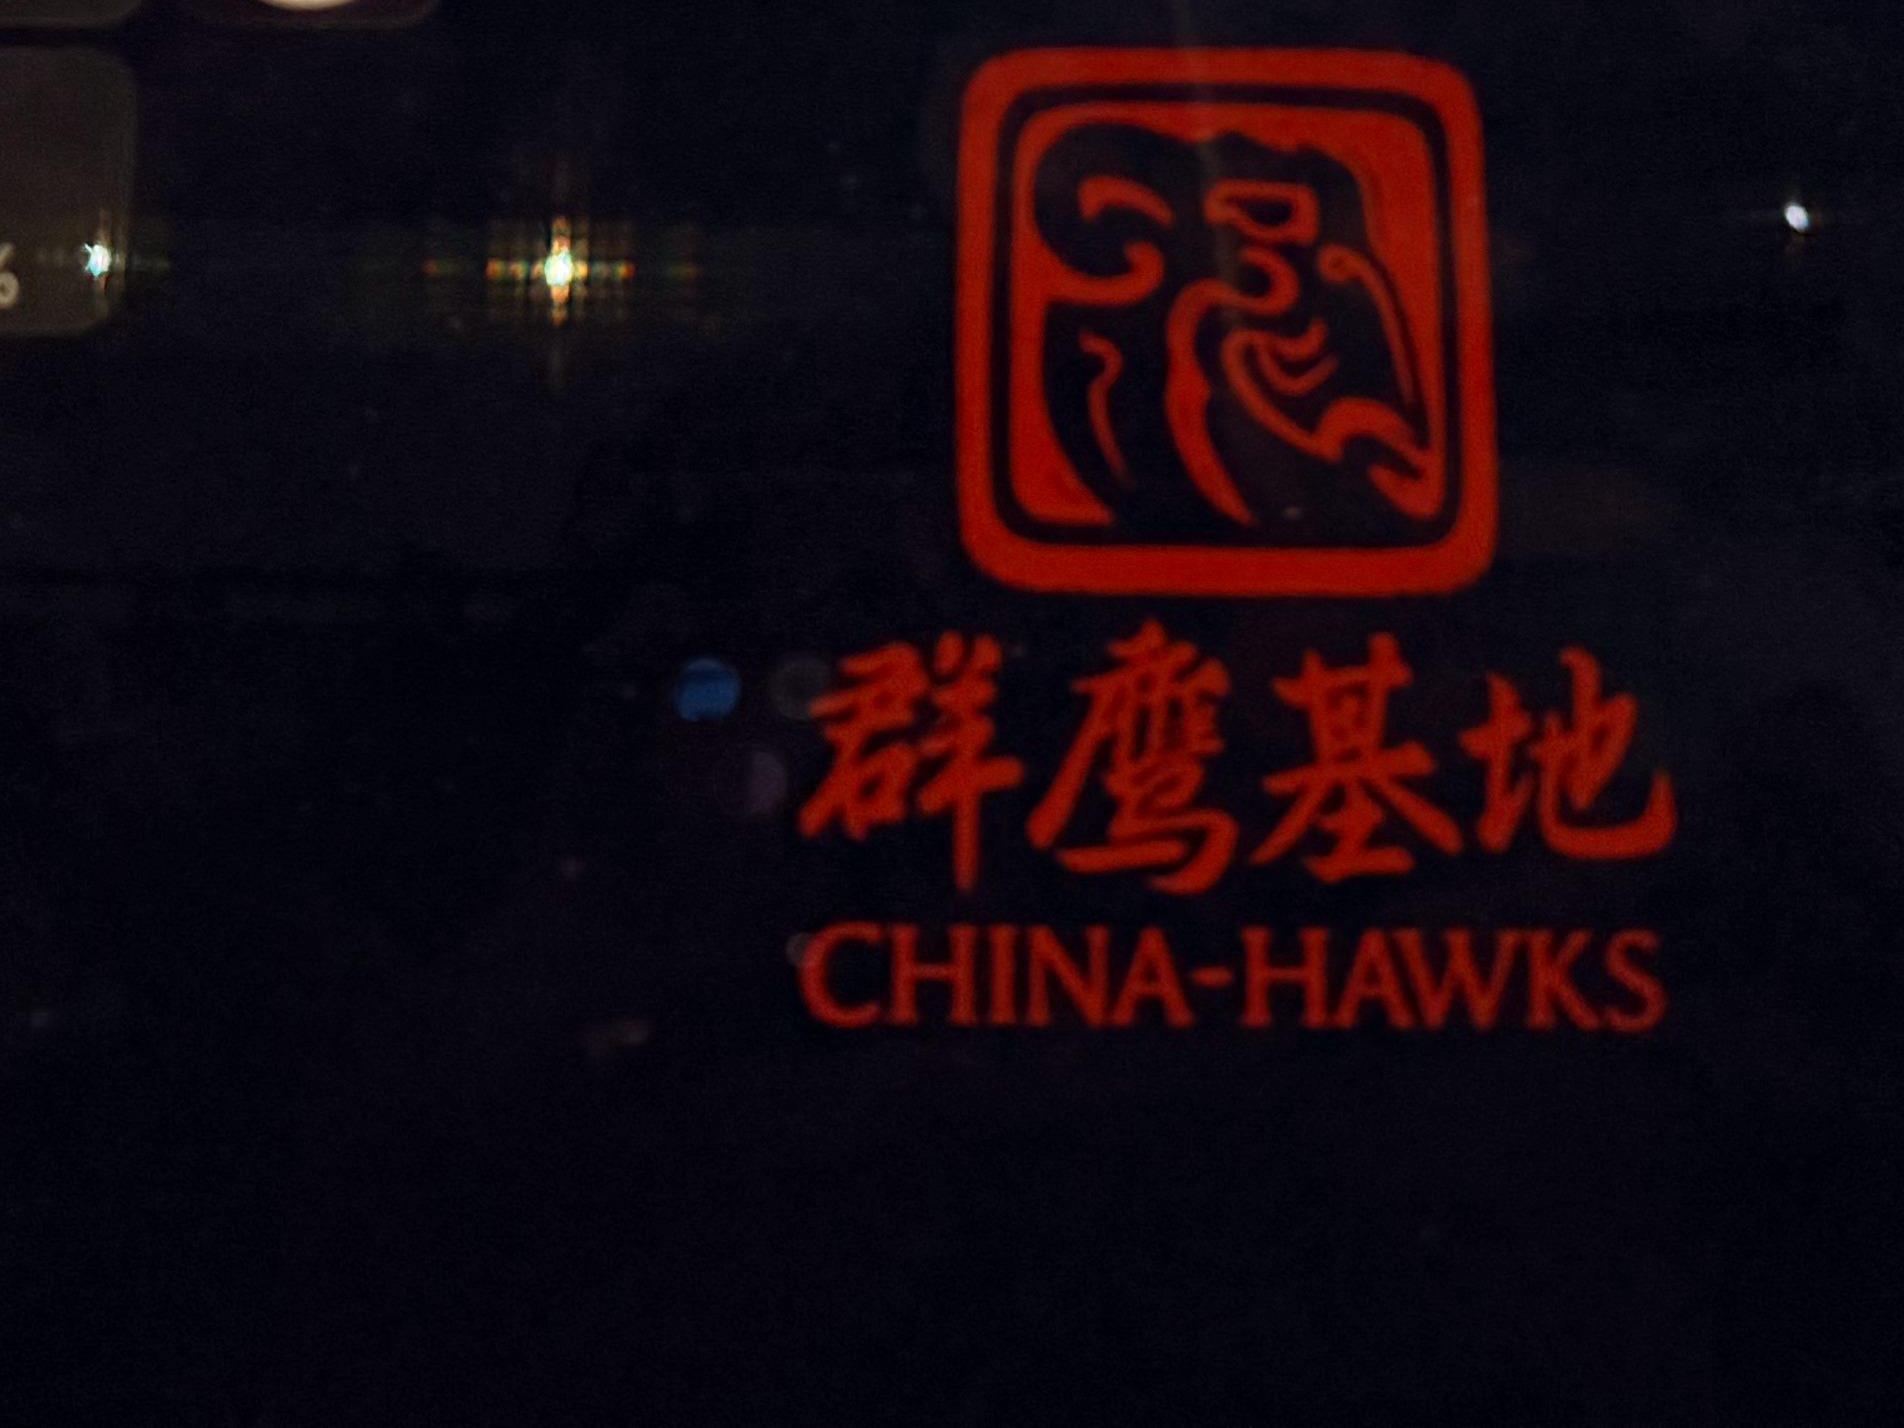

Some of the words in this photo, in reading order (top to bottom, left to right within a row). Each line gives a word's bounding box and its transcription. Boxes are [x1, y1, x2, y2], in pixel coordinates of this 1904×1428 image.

[796, 617, 1678, 896] 群鹰基地
[798, 919, 1669, 1033] CHINA-HAWKS
